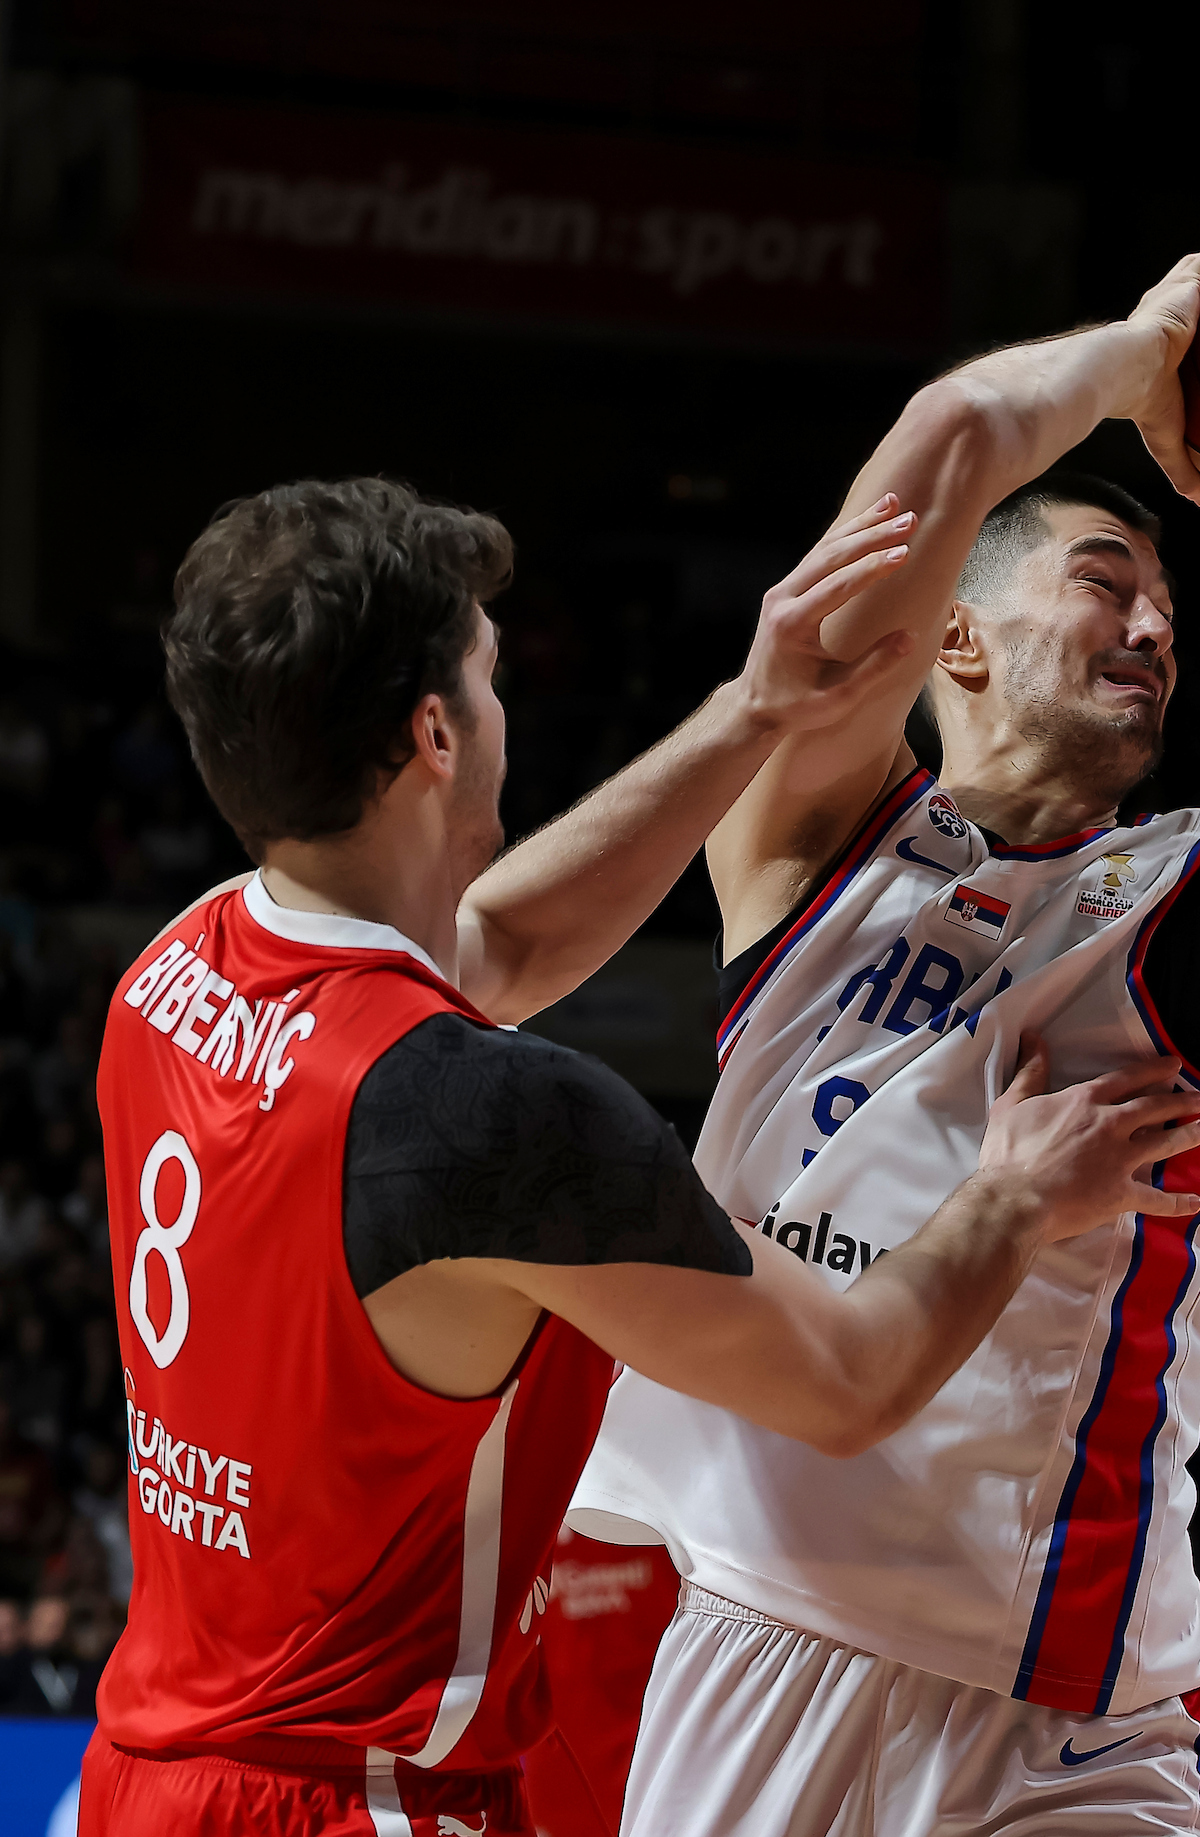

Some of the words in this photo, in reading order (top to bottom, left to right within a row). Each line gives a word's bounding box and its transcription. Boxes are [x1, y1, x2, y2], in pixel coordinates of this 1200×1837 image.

[1080, 896, 1113, 908] WORLD
[1115, 902, 1134, 910] CUP
[129, 1129, 202, 1370] 8
